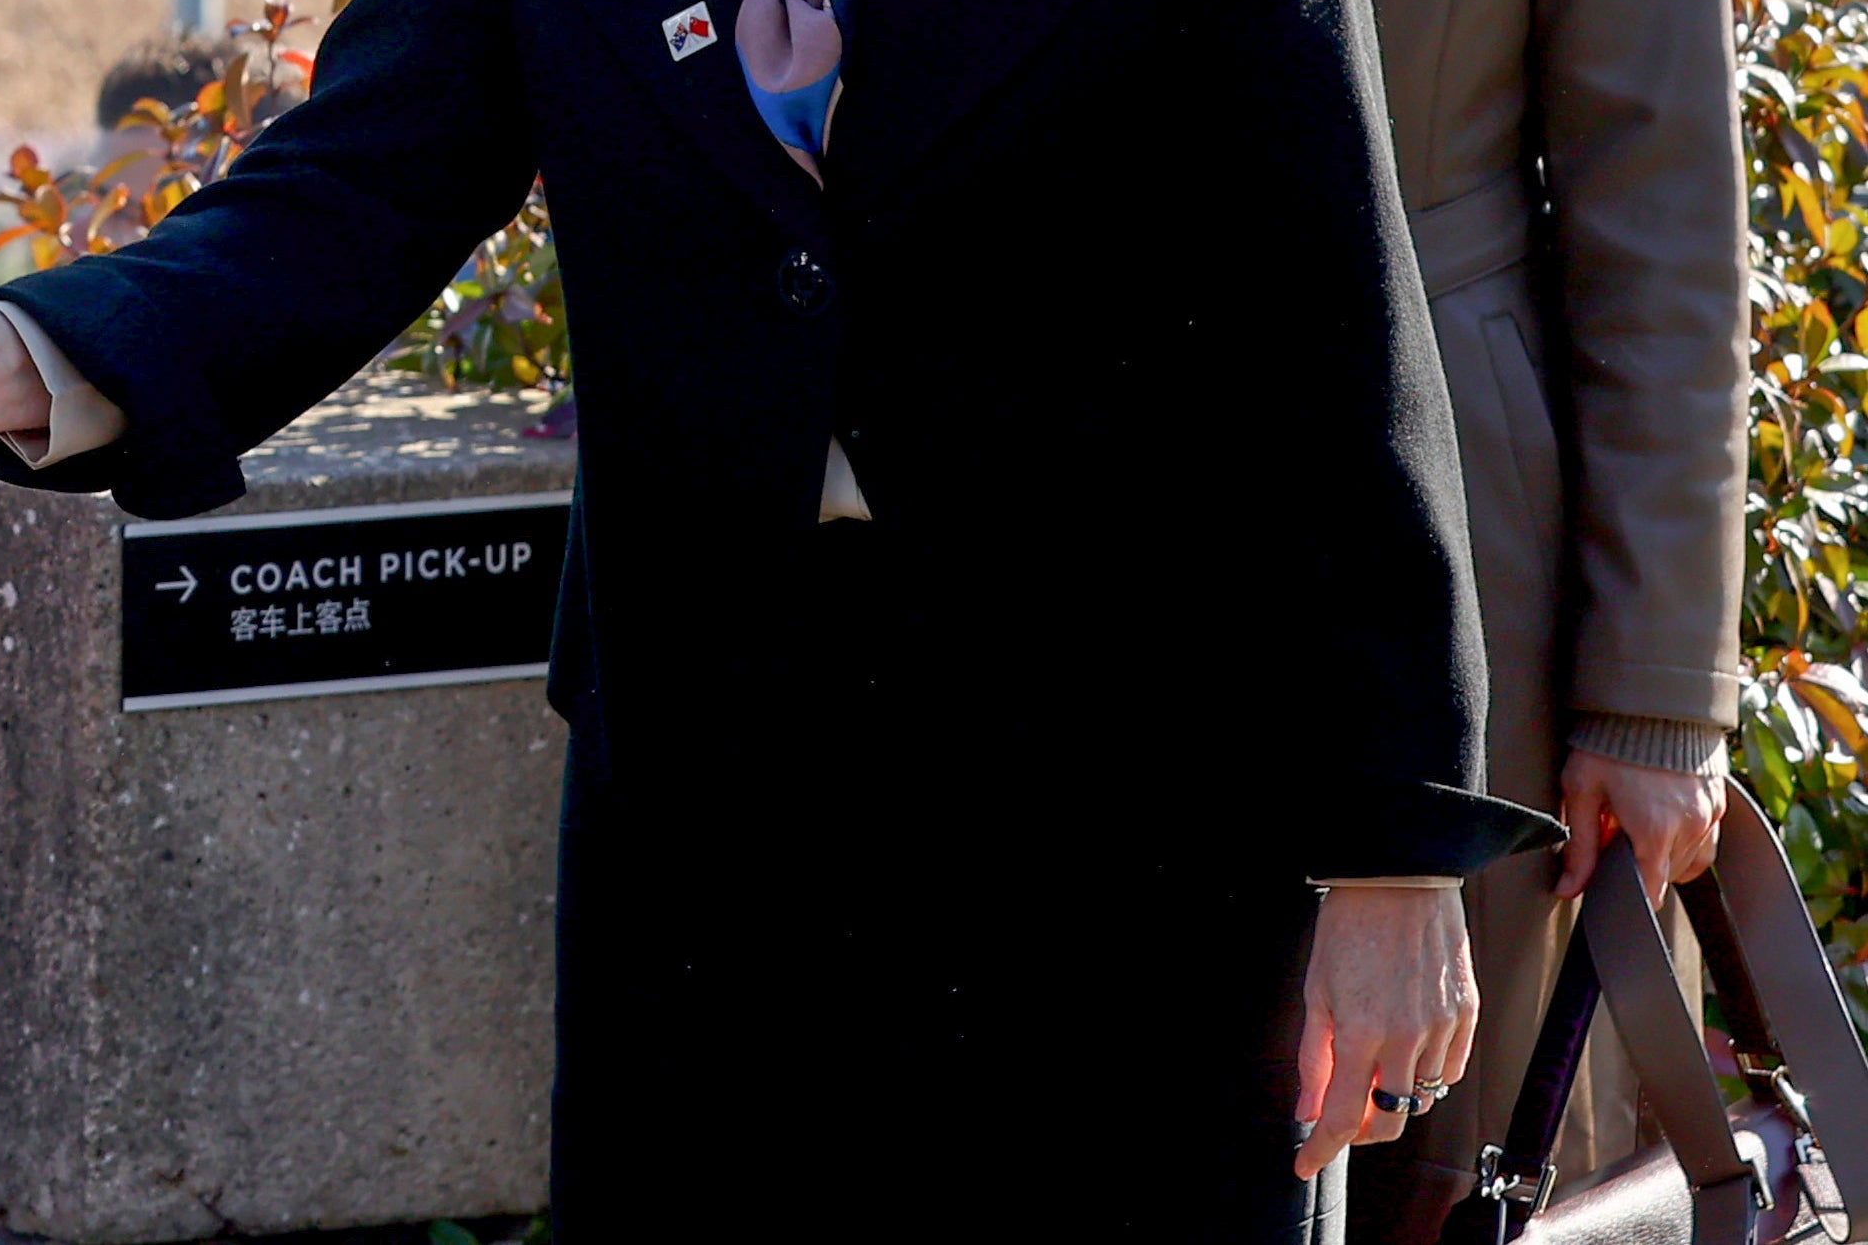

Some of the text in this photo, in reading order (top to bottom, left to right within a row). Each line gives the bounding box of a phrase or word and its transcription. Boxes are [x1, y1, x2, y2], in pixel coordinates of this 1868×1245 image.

[230, 542, 531, 595] COACH PICK-UP
[230, 597, 371, 641] 客车上客点
